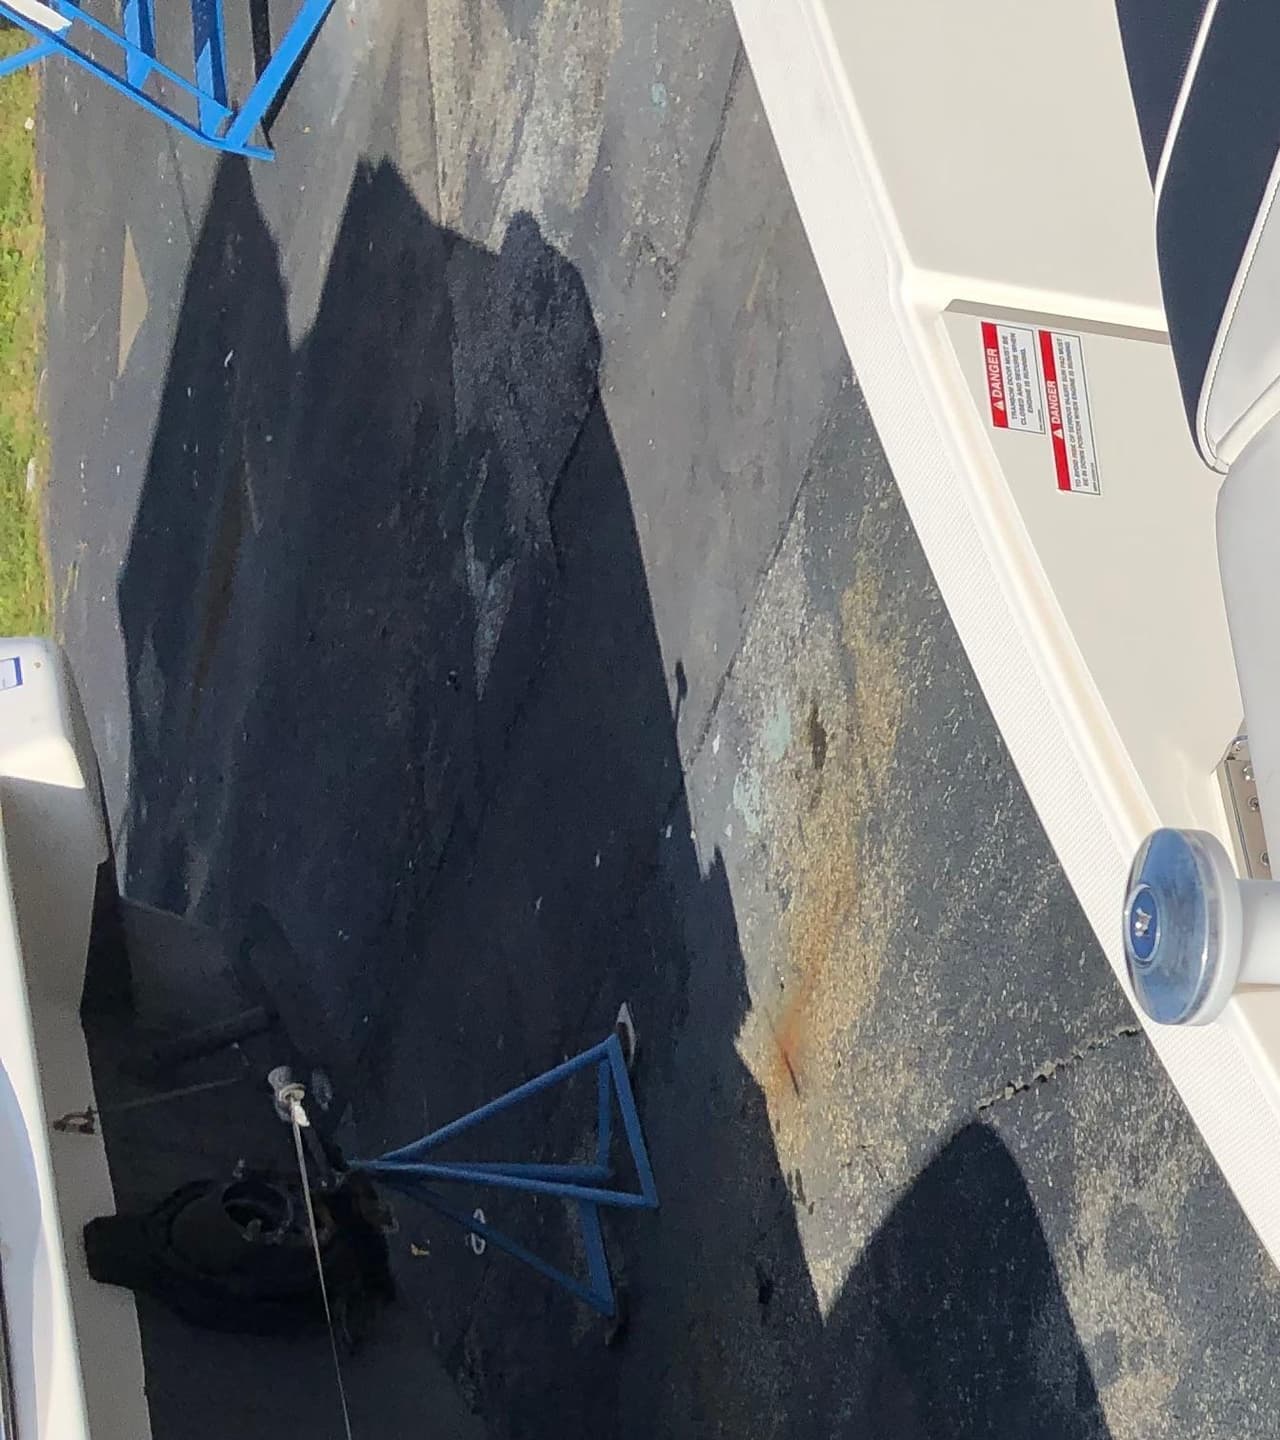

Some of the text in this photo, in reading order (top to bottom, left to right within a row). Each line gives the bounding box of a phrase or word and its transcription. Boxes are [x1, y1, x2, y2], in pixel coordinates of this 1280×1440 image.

[1002, 336, 1008, 344] BE
[986, 348, 1003, 398] DANGER
[1018, 398, 1026, 425] CLOSED
[1025, 389, 1033, 413] ENGINE
[1047, 380, 1061, 424] DANGER
